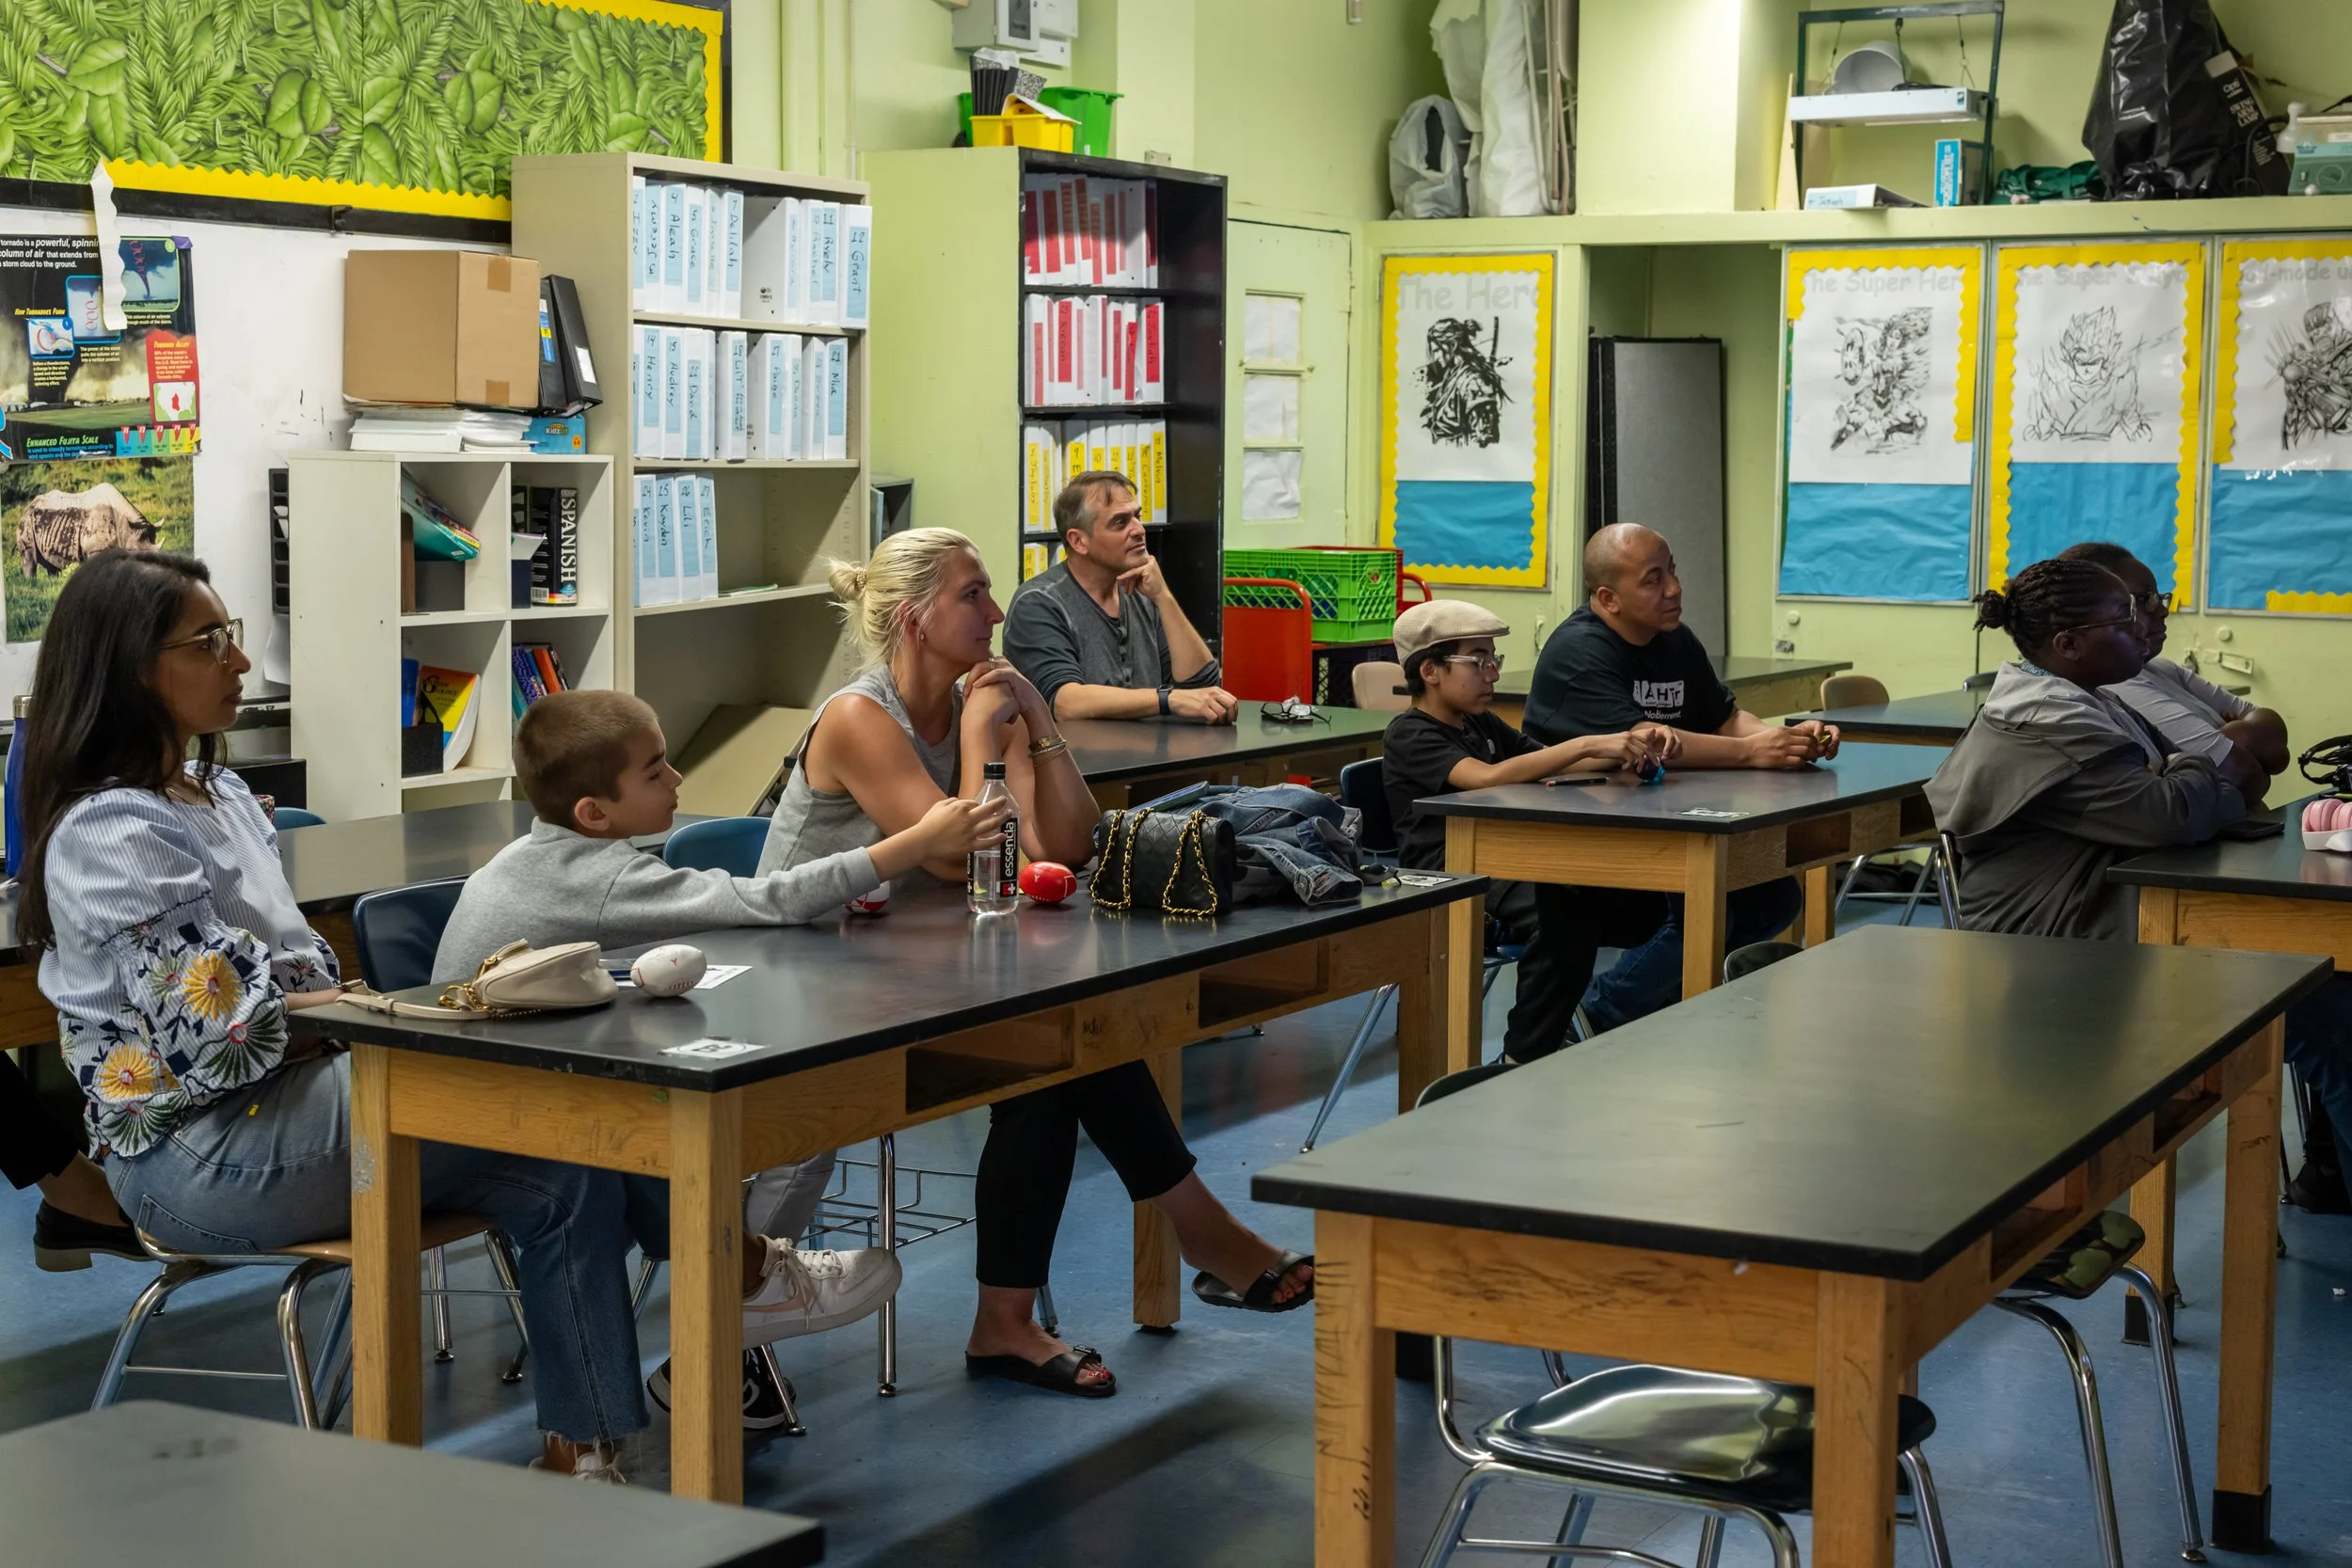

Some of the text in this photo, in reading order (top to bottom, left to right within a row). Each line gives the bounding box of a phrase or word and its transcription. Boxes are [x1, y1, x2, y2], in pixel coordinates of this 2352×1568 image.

[2230, 97, 2254, 115] SWING
[2236, 105, 2255, 119] ARM
[2237, 112, 2259, 128] LAMP
[36, 238, 71, 248] powerful,
[72, 238, 99, 249] spinni
[647, 199, 660, 259] Jeremy
[728, 214, 739, 267] Delilah
[0, 248, 24, 258] column
[25, 249, 33, 258] of
[34, 249, 44, 258] air
[55, 261, 77, 269] ground.
[690, 229, 698, 269] Grace
[851, 231, 866, 293] 12 Grant
[1845, 272, 1912, 298] Super
[1918, 270, 1962, 293] Her
[2055, 268, 2118, 292] Super
[644, 356, 656, 400] Henry
[666, 362, 678, 406] Audrey
[690, 385, 699, 420] David
[643, 507, 651, 543] Kevin
[659, 483, 670, 546] 25 Kayden
[561, 499, 577, 582] SPANISH
[1005, 821, 1015, 877] essentia
